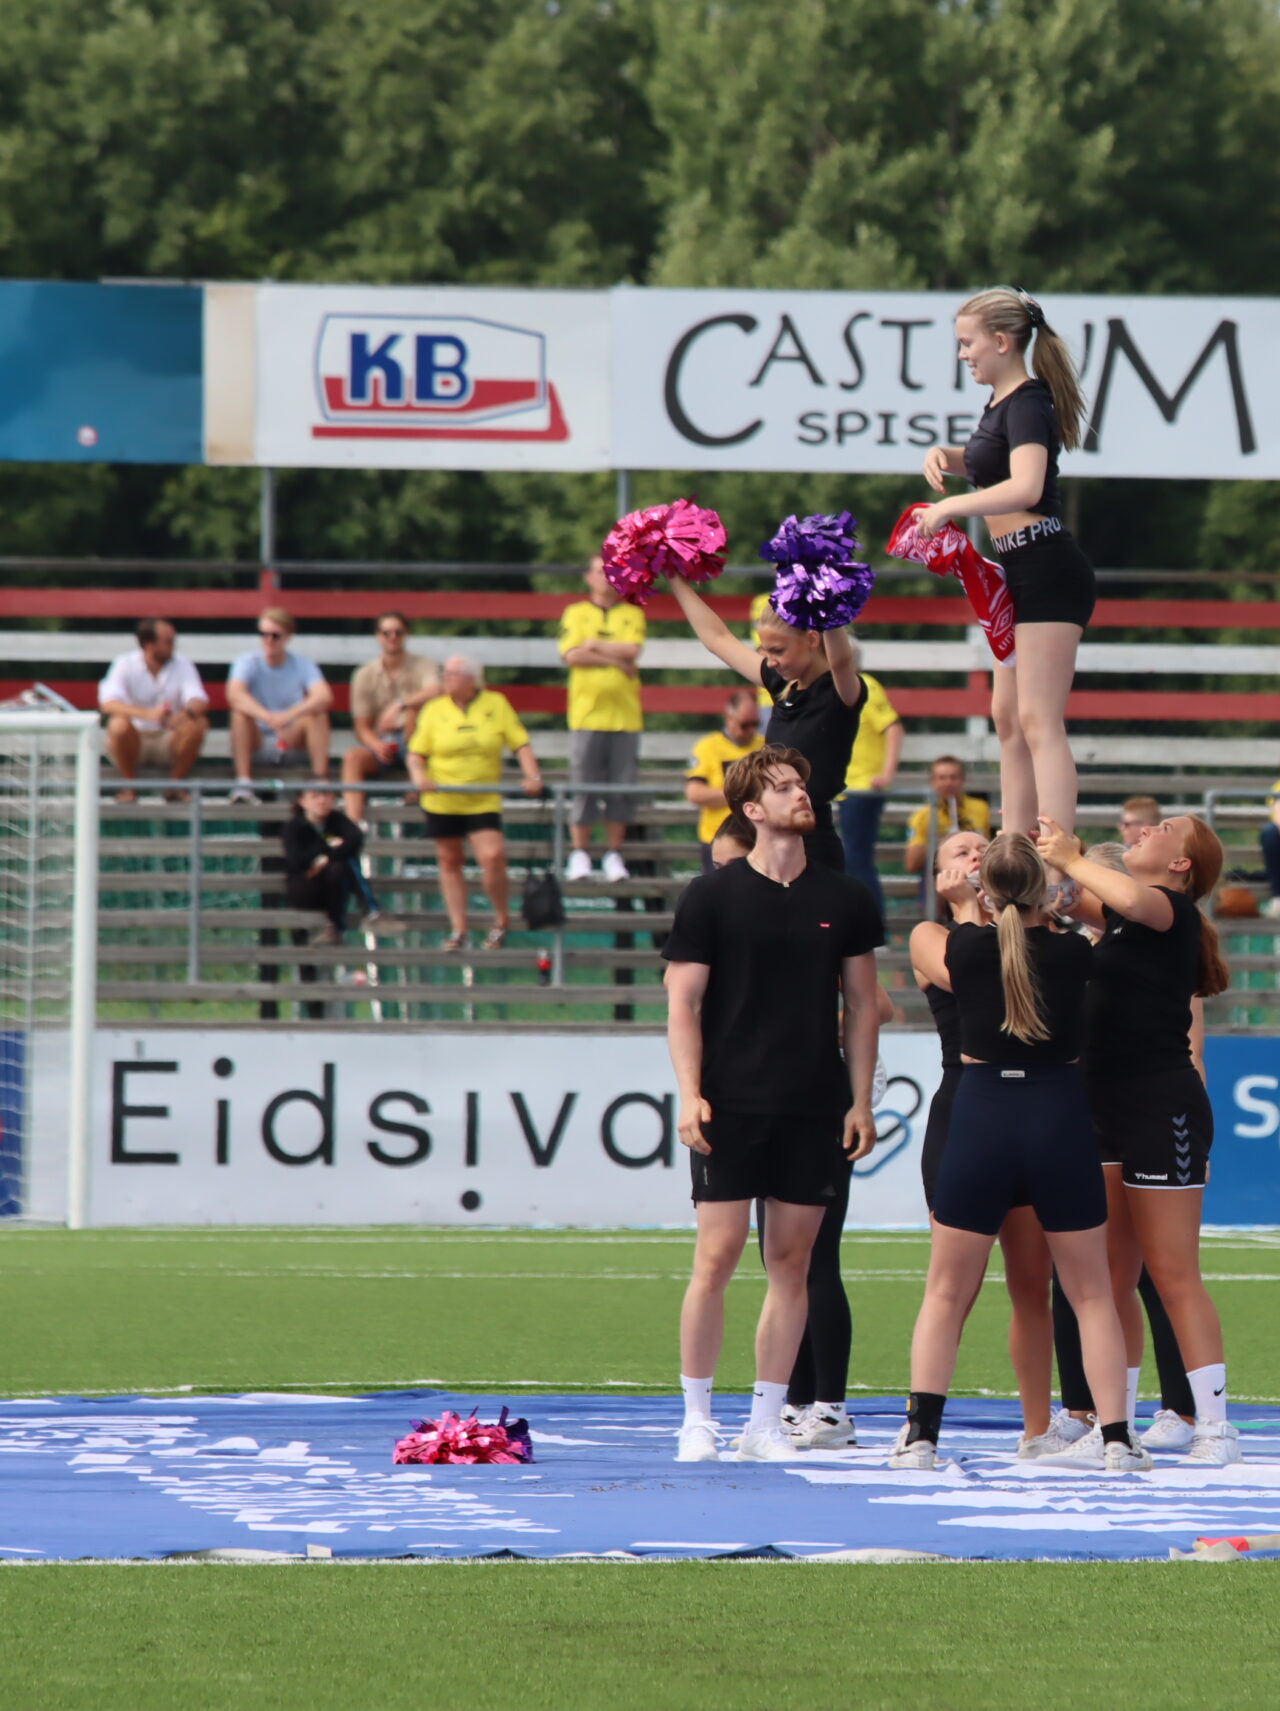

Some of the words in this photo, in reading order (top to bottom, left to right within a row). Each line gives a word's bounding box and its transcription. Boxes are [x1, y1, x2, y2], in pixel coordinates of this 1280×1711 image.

[348, 332, 471, 402] KB
[663, 312, 1257, 456] CASTM
[994, 527, 1028, 554] NIKE
[110, 1056, 676, 1211] Eidsiva
